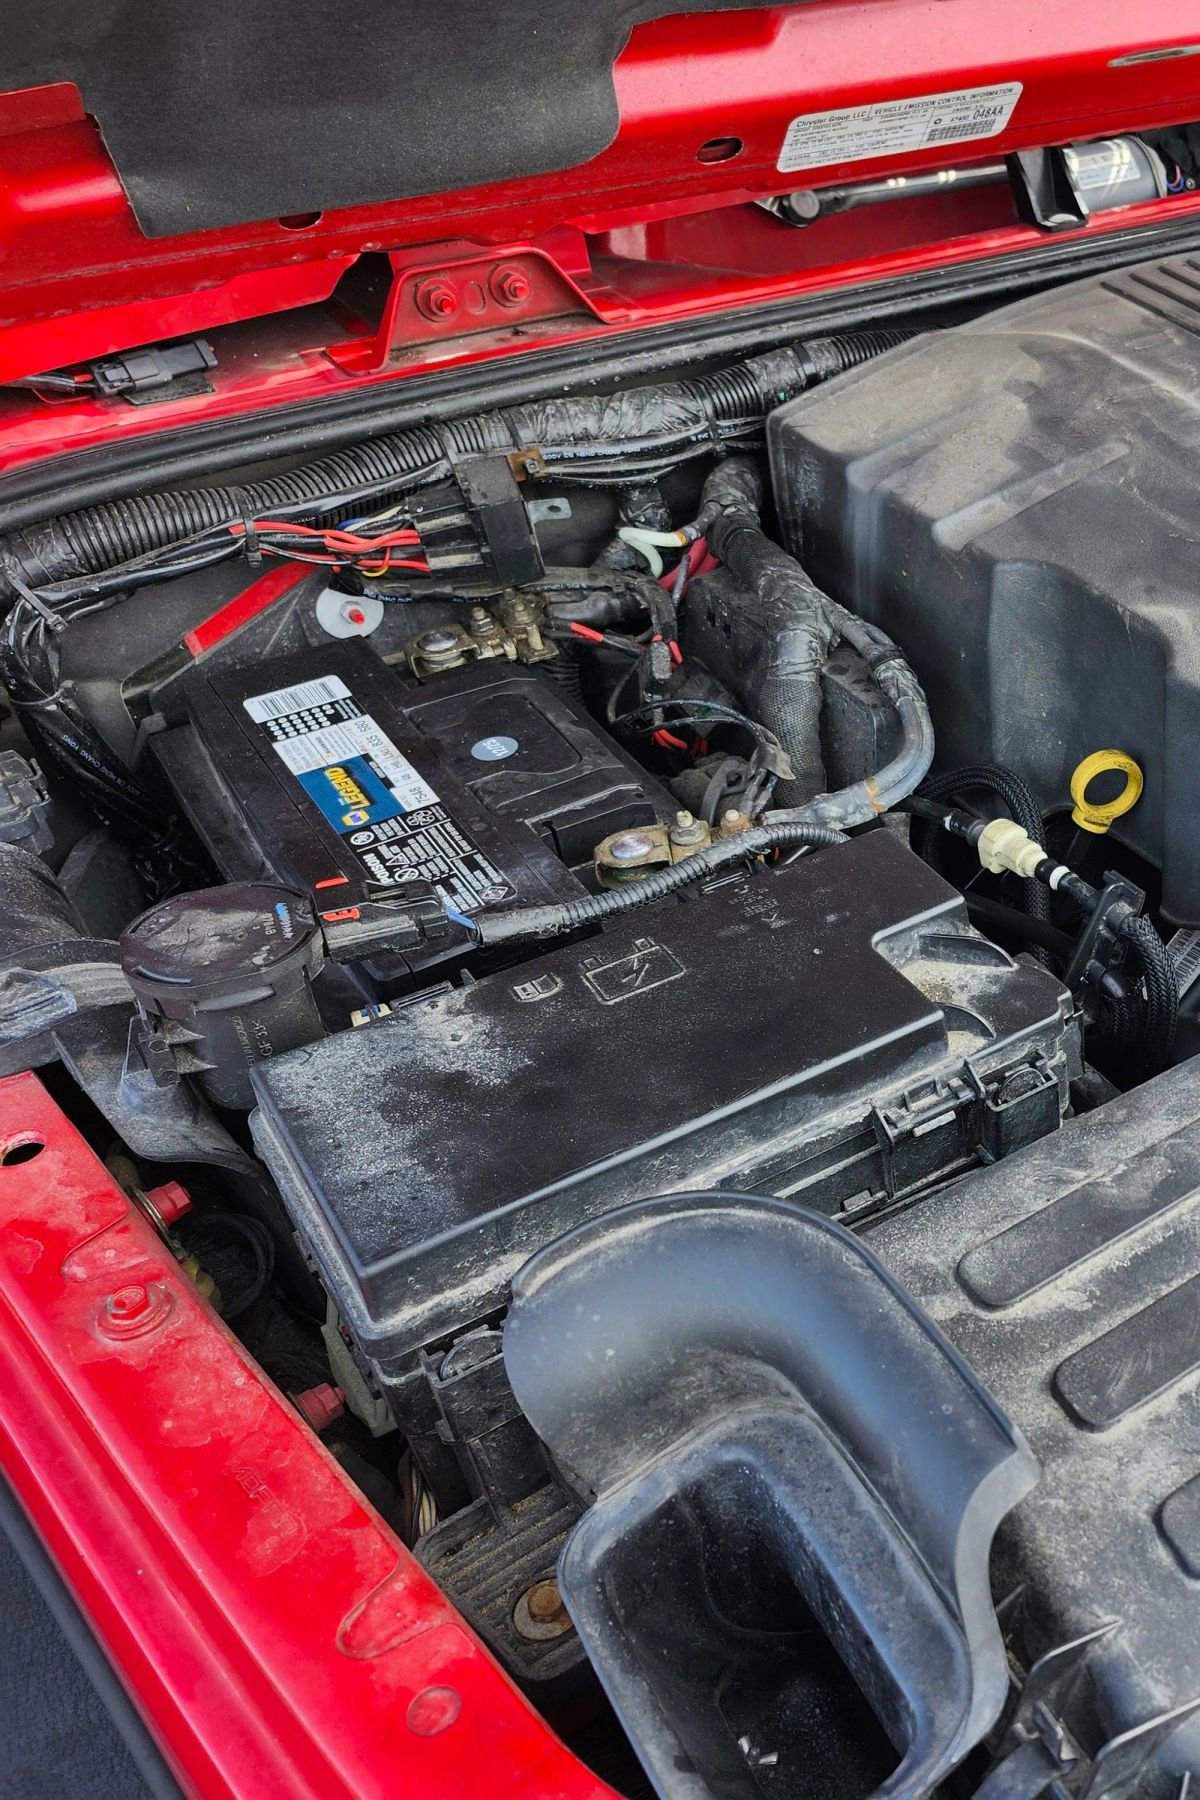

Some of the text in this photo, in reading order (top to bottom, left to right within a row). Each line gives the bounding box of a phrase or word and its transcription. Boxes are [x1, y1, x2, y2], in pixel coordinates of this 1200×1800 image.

[874, 105, 903, 116] VEHICLE
[904, 99, 937, 110] EMISSION
[937, 94, 968, 105] CONTROL
[969, 87, 1014, 100] INFORMATION
[972, 106, 1005, 120] 048AA
[324, 766, 373, 810] LEGEND
[407, 786, 431, 803] 7548
[362, 852, 395, 884] POISON
